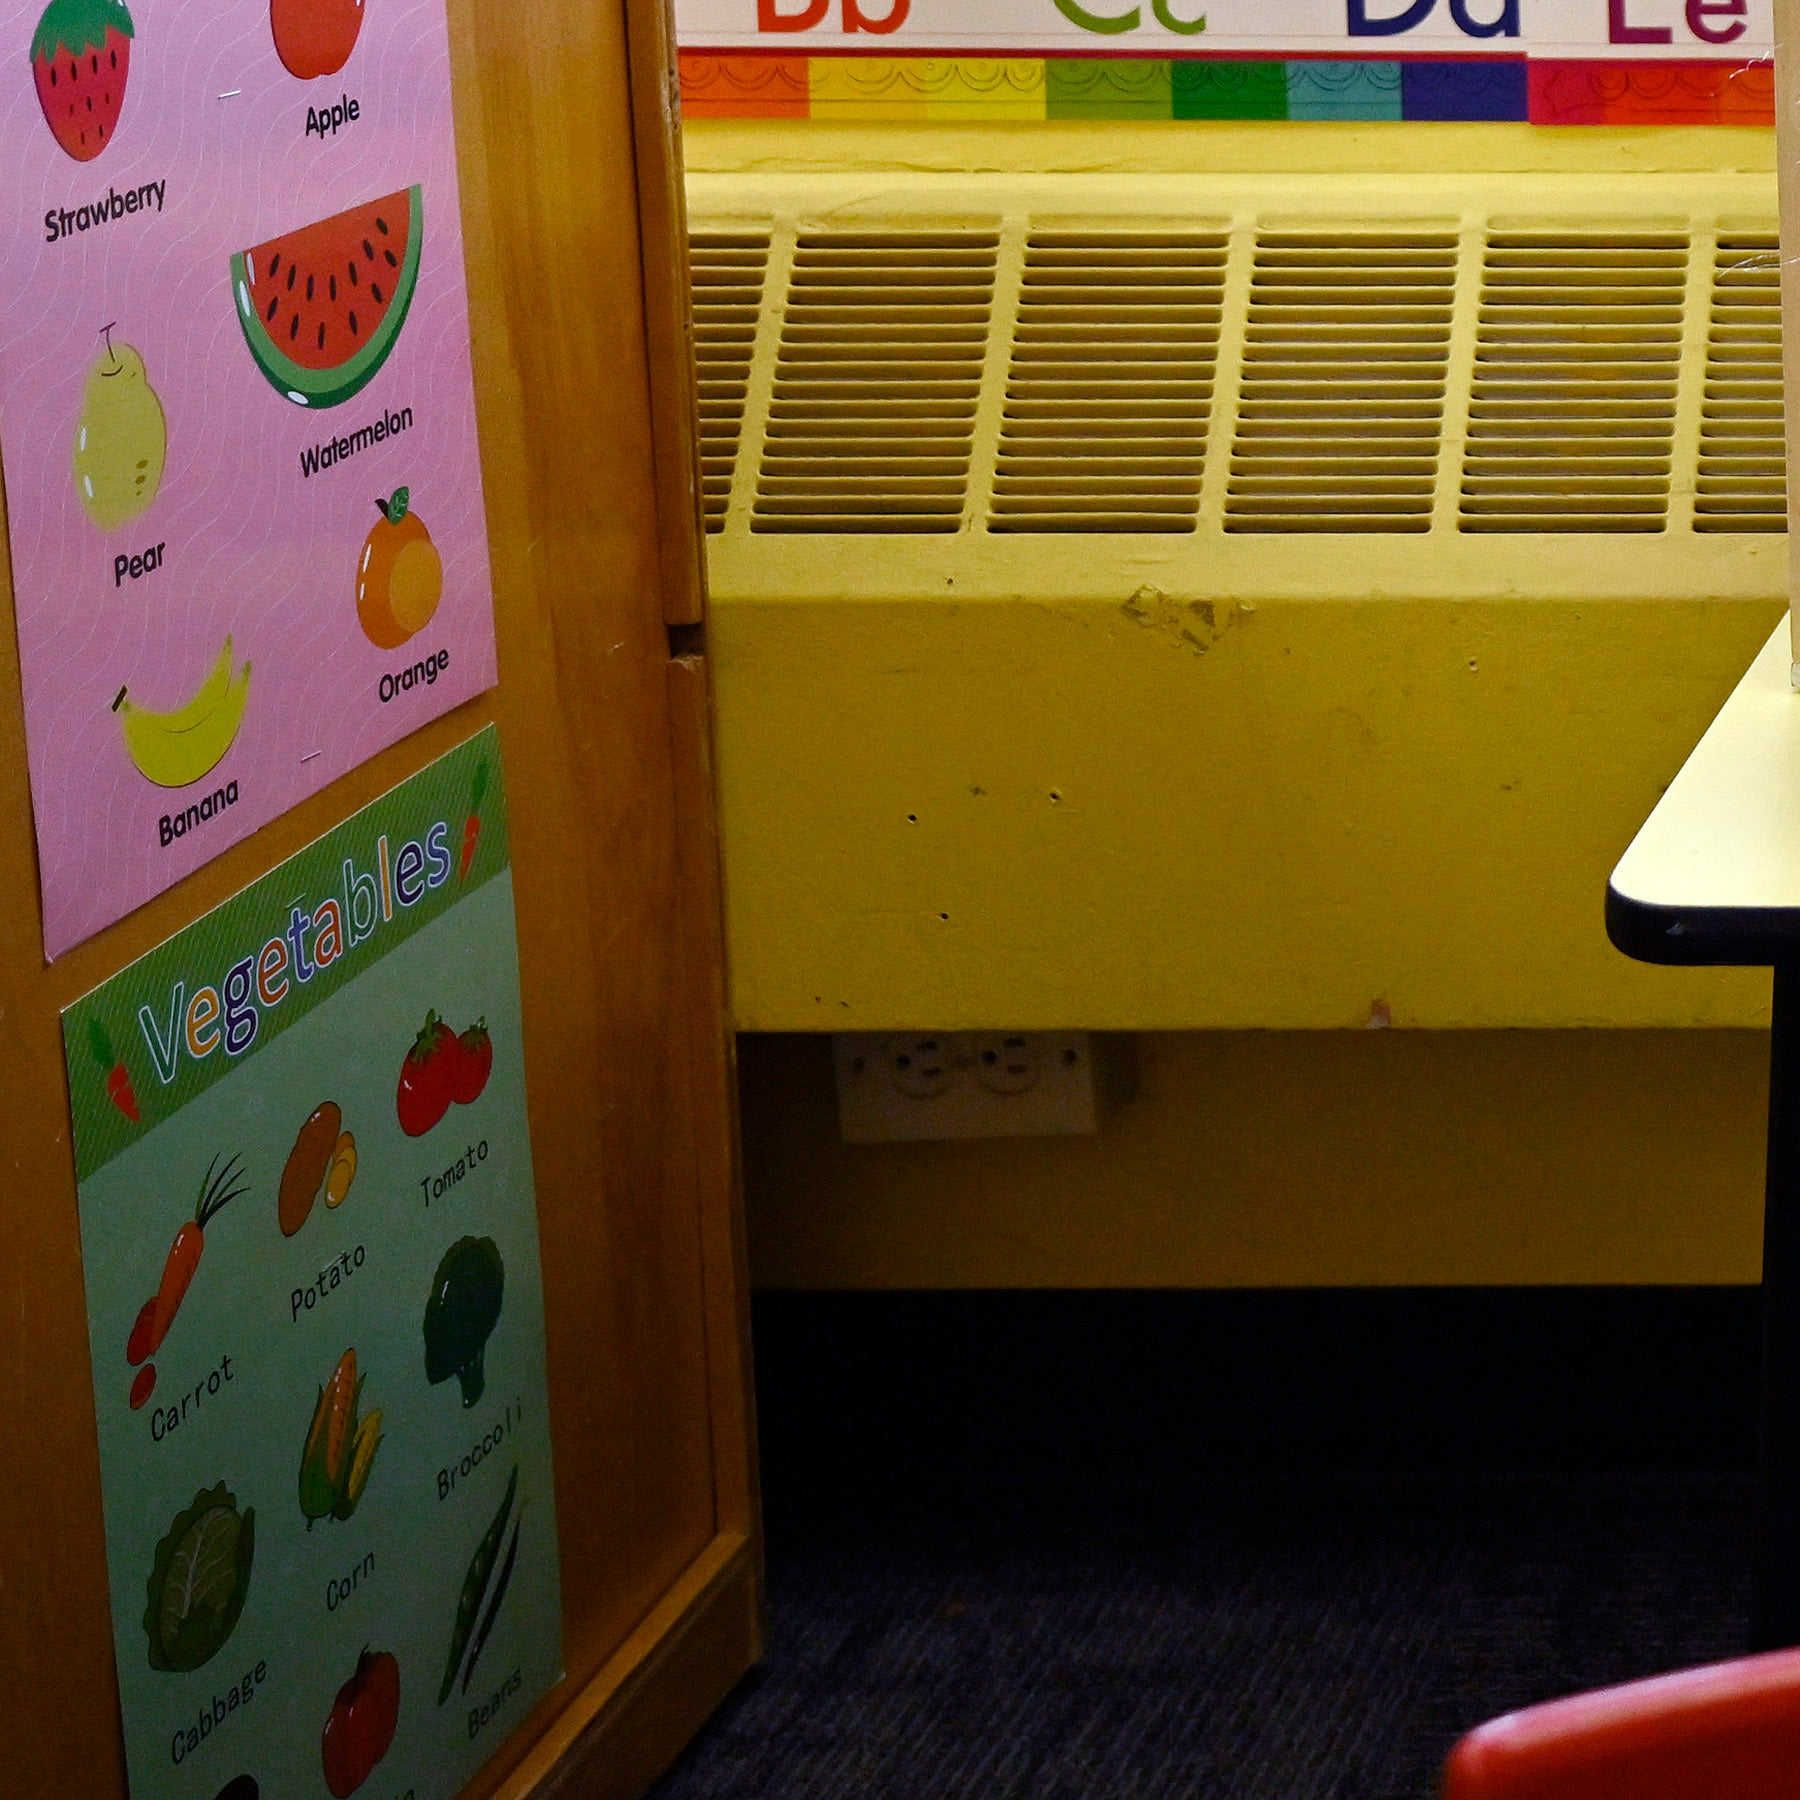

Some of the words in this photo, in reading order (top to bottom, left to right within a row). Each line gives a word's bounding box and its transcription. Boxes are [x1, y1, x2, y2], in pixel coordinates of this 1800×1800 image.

[305, 94, 360, 139] Apple
[44, 178, 167, 243] Strawberry
[300, 407, 414, 479] Watermelon
[114, 540, 167, 587] Pear
[379, 647, 450, 703] Orange
[158, 777, 240, 848] Banana
[138, 821, 451, 1084] Vegetables
[420, 1139, 489, 1208] Tomato
[290, 1244, 366, 1322] Potato
[151, 1354, 235, 1442] Carrot
[436, 1397, 523, 1501] Broccoli
[325, 1551, 376, 1612] Corn
[170, 1659, 267, 1766] Cabbage
[467, 1667, 523, 1740] Beans
